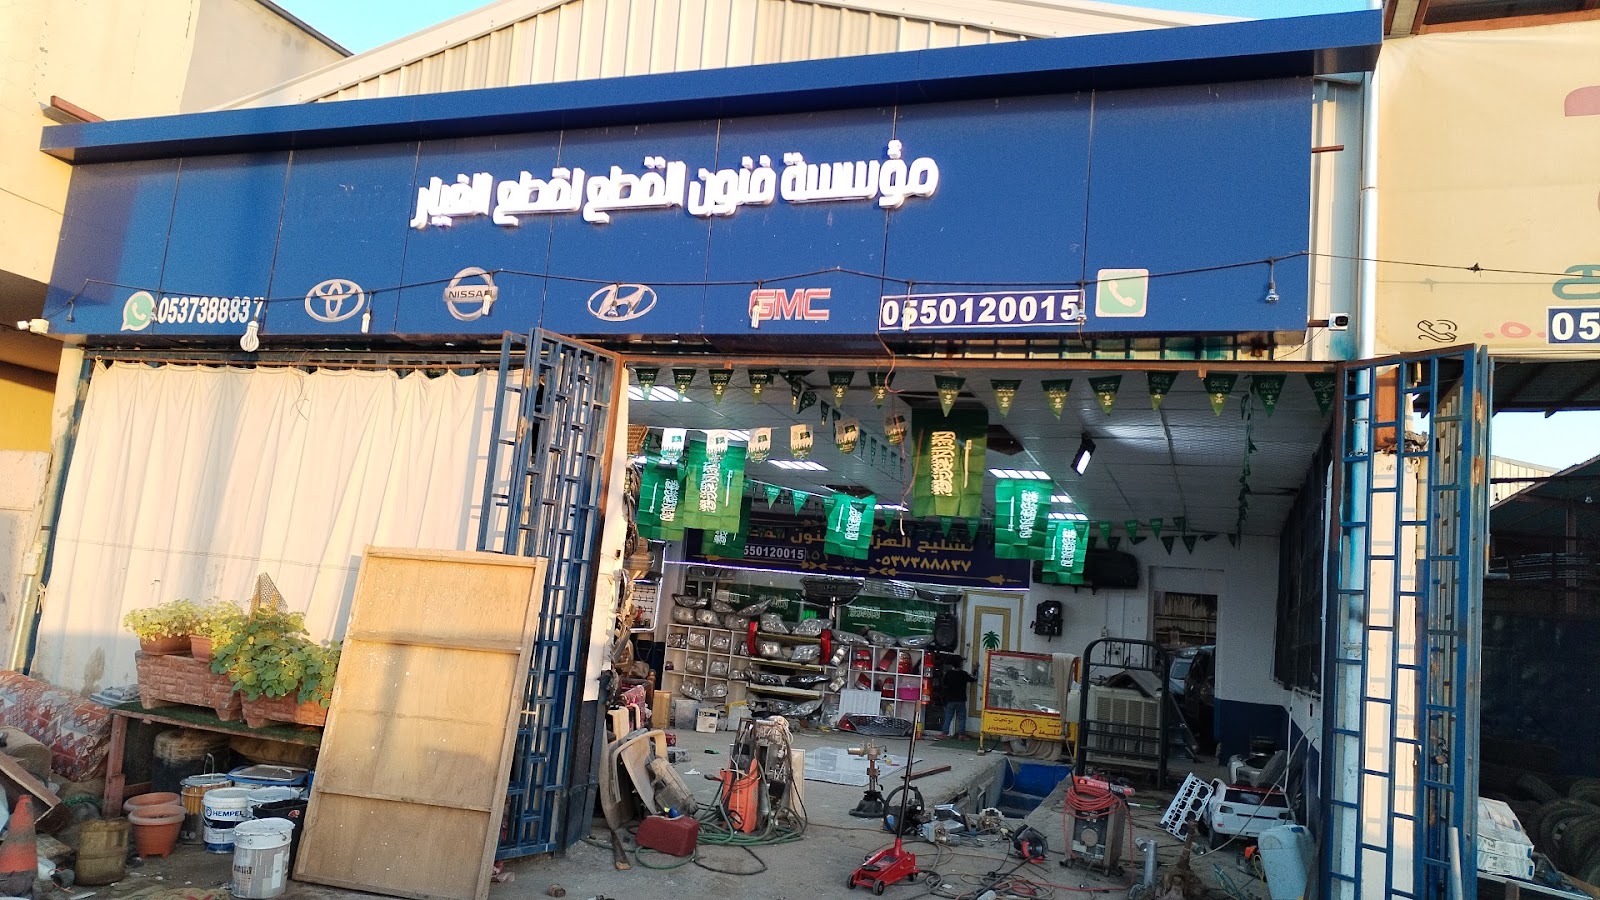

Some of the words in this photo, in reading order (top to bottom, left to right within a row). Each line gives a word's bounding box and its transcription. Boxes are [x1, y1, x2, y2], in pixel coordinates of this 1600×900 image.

[583, 156, 687, 224] القطع
[688, 154, 776, 217] فنون
[782, 139, 939, 207] مؤسسة
[409, 171, 493, 230] الغيار
[492, 167, 585, 228] لقطع
[157, 296, 265, 324] 0537388837
[750, 288, 831, 321] GMC
[743, 545, 805, 560] 550120015
[791, 528, 826, 545] نون
[875, 555, 972, 572] ٠٥٣٧٣٨٨٨٣٧
